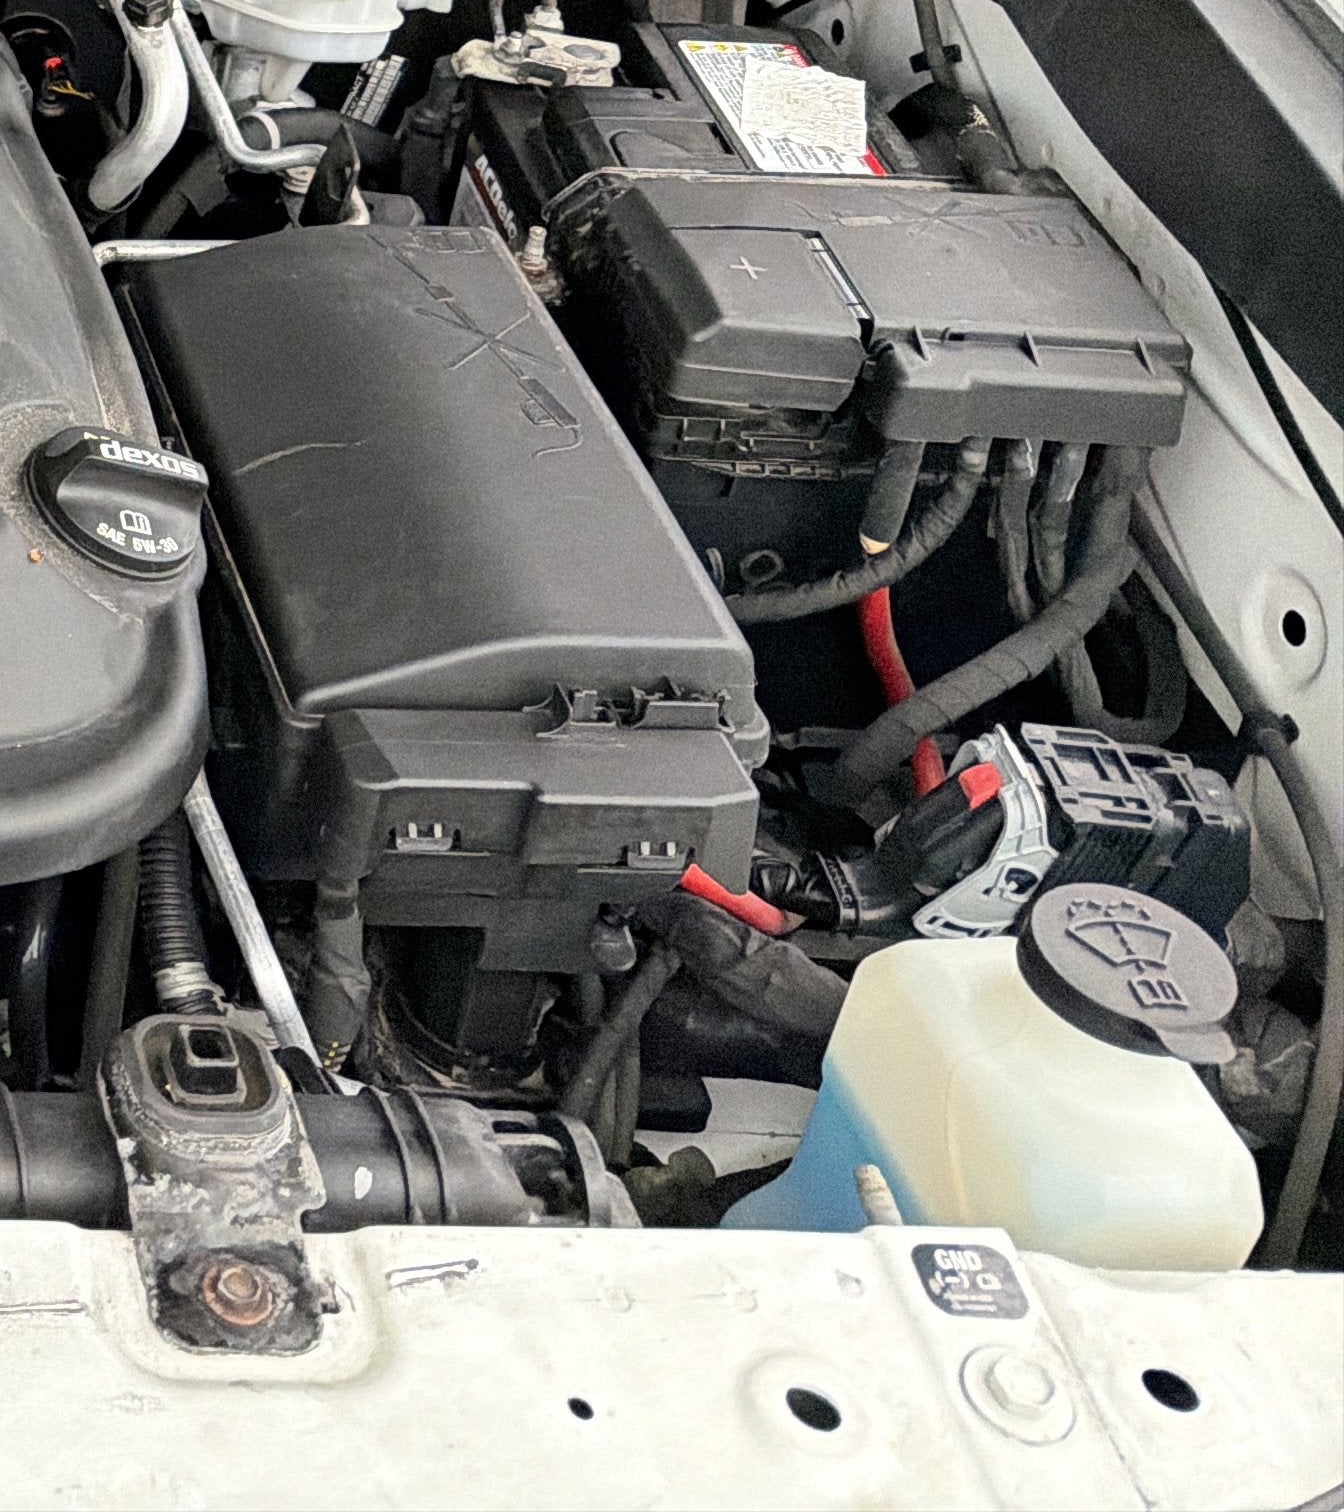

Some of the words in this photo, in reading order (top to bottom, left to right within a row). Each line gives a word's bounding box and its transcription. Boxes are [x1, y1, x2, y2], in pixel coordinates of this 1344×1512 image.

[100, 440, 200, 480] dexos
[96, 522, 126, 546] SAE
[132, 536, 178, 555] 5W-30
[933, 1249, 982, 1271] GND
